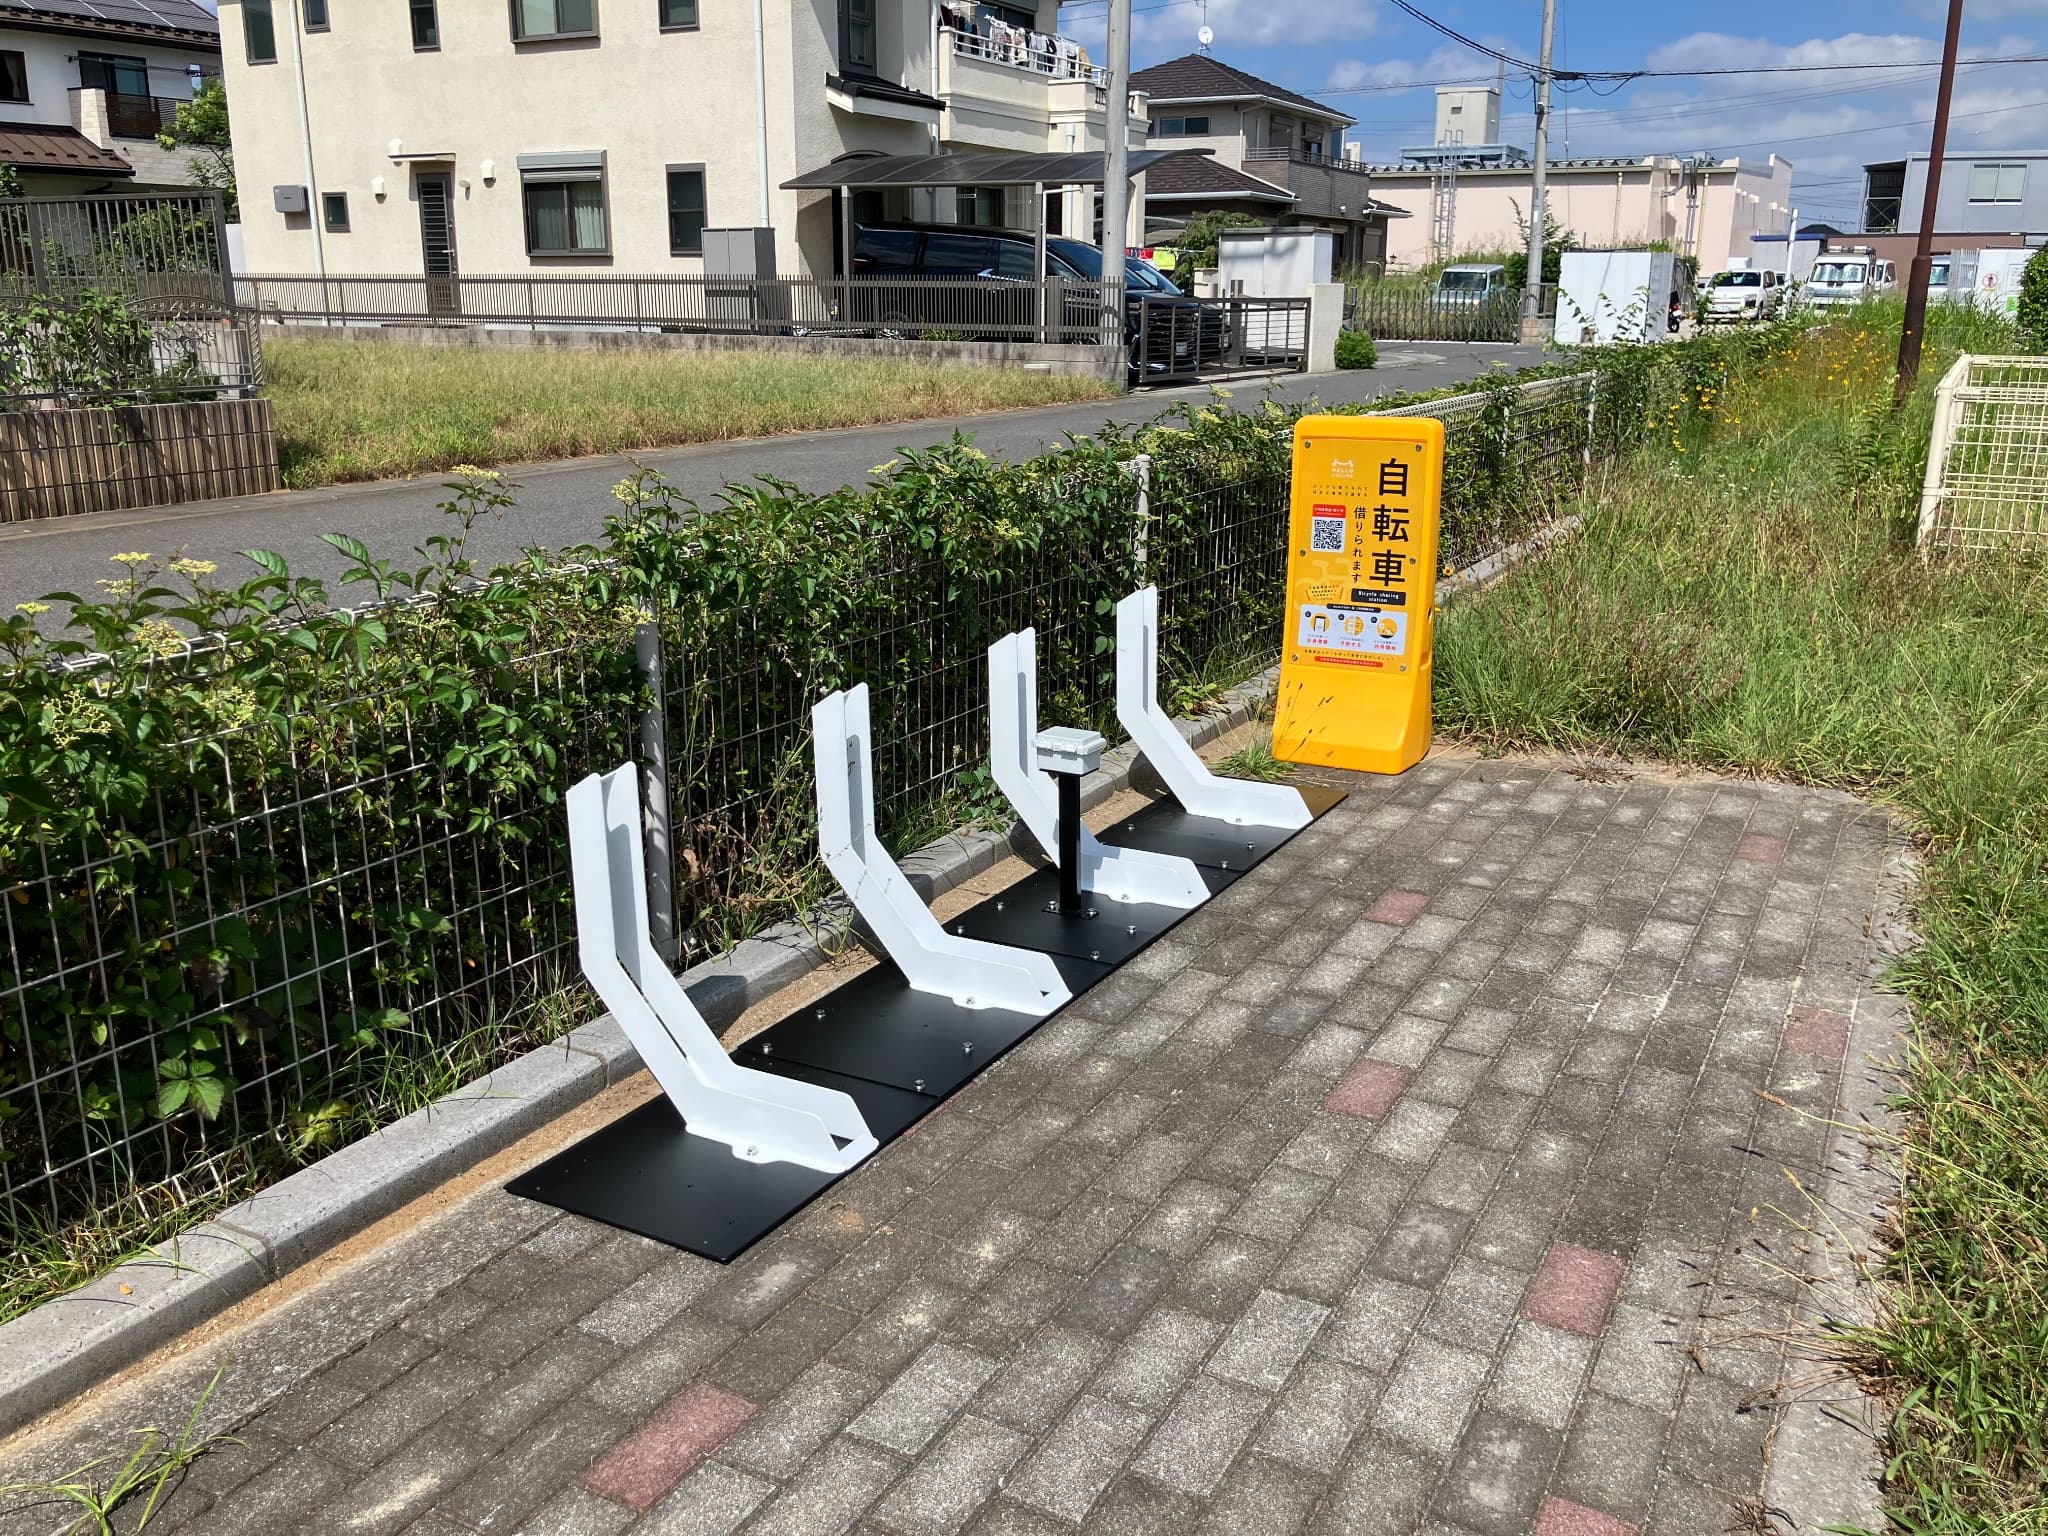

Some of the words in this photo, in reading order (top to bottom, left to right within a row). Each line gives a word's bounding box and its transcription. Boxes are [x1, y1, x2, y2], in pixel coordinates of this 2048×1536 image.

[1351, 506, 1367, 584] 借りられます
[1369, 457, 1410, 587] 自転車
[1379, 592, 1399, 600] sharing
